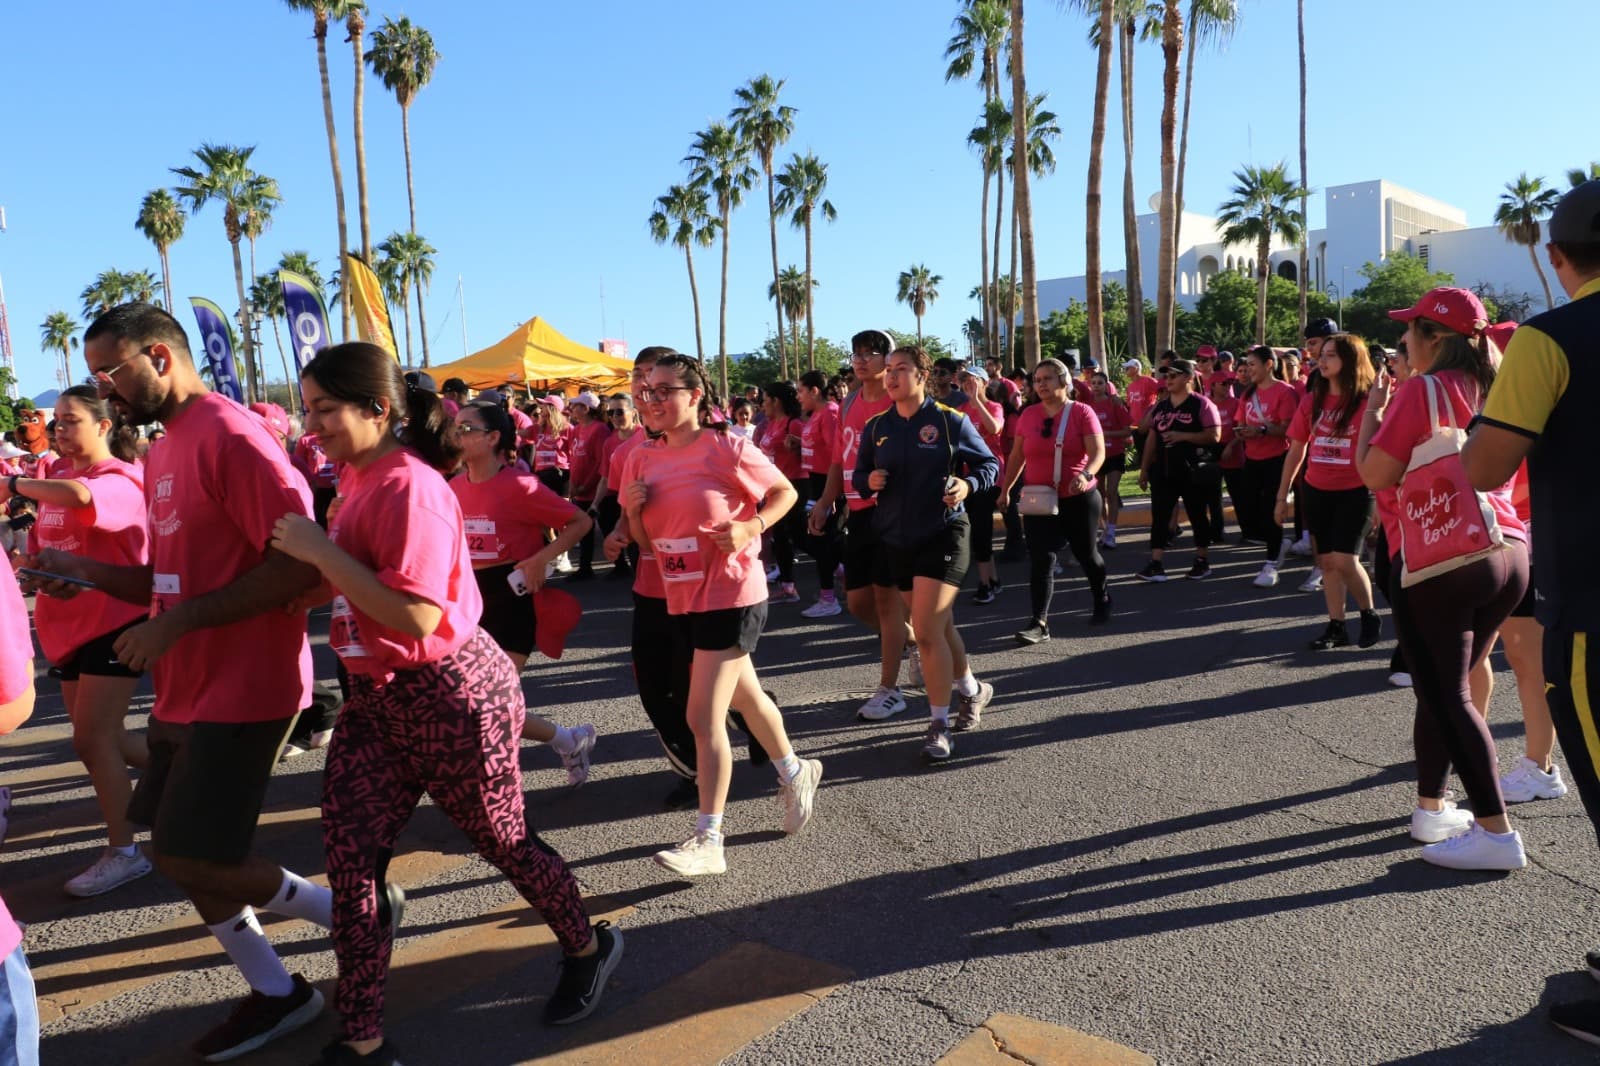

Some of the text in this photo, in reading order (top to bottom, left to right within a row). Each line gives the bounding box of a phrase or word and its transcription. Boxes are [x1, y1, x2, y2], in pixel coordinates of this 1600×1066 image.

[1406, 488, 1461, 521] lucky
[1421, 513, 1437, 528] in
[1424, 517, 1462, 545] love
